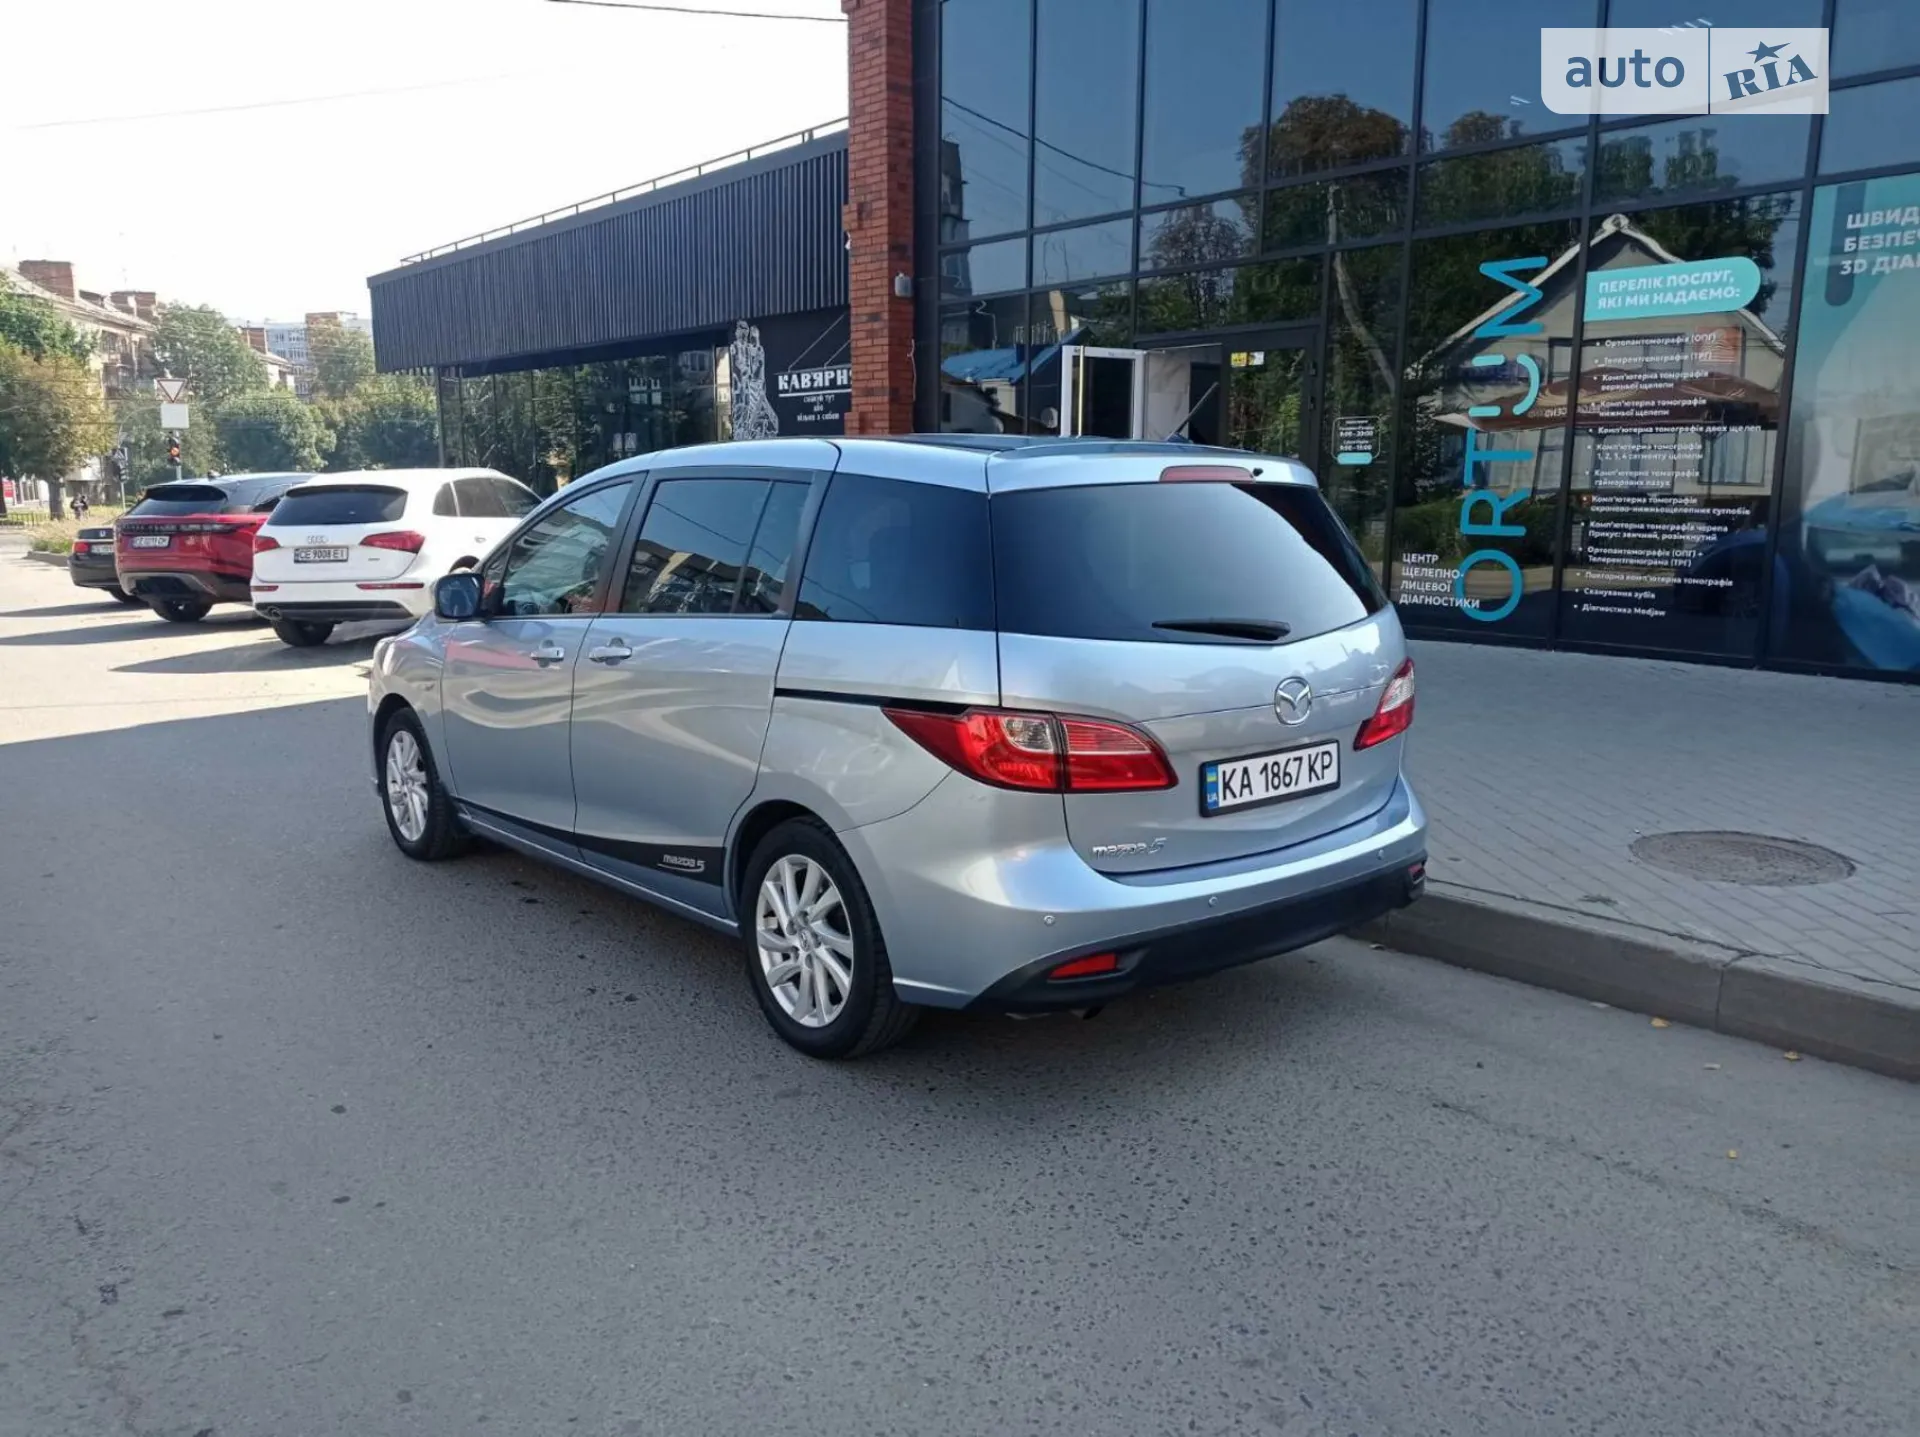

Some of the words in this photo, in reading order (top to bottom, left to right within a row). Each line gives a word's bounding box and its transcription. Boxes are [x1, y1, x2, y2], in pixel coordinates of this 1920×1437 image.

[1844, 229, 1920, 253] БЕЗПЕ
[1599, 275, 1665, 293] ПЕРЕЛІК
[1666, 269, 1735, 287] ПОСЛУГ,
[1598, 295, 1623, 310] ЯКІ
[1625, 293, 1651, 307] МИ
[1652, 286, 1741, 306] НАДАЄМО:
[1402, 553, 1439, 565] ЦЕНТР
[1401, 565, 1464, 579] ЩЕЛЕПНО-
[1400, 580, 1453, 593] ЛИЦЕВОЇ
[1399, 593, 1480, 608] ДІАГНОСТИКИ
[1222, 766, 1253, 801] KA
[1260, 756, 1303, 793] 1867
[1308, 750, 1333, 783] KP
